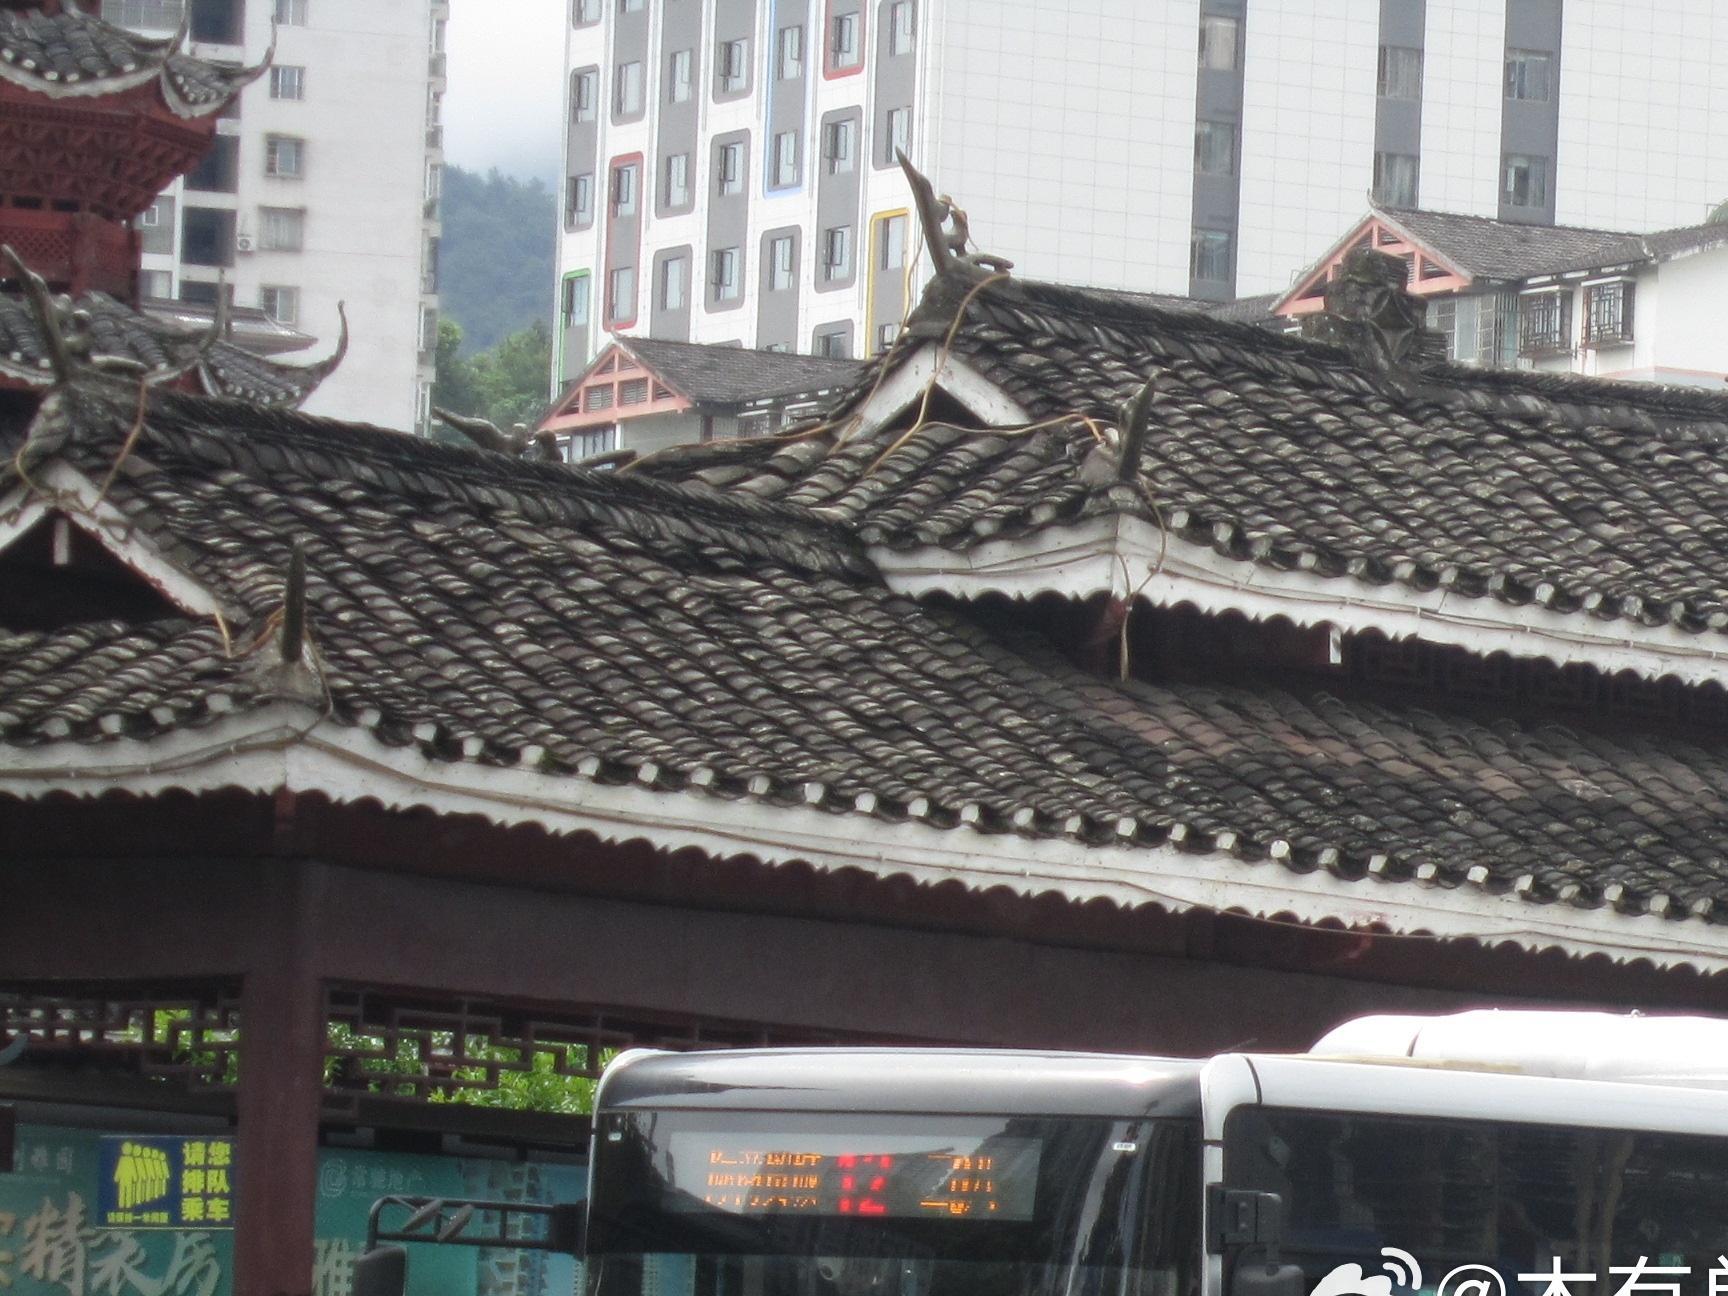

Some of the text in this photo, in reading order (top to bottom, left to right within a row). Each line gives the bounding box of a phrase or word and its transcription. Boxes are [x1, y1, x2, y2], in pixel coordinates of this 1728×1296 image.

[181, 1141, 231, 1166] 请您
[181, 1169, 231, 1194] 排队
[181, 1197, 231, 1222] 乘车
